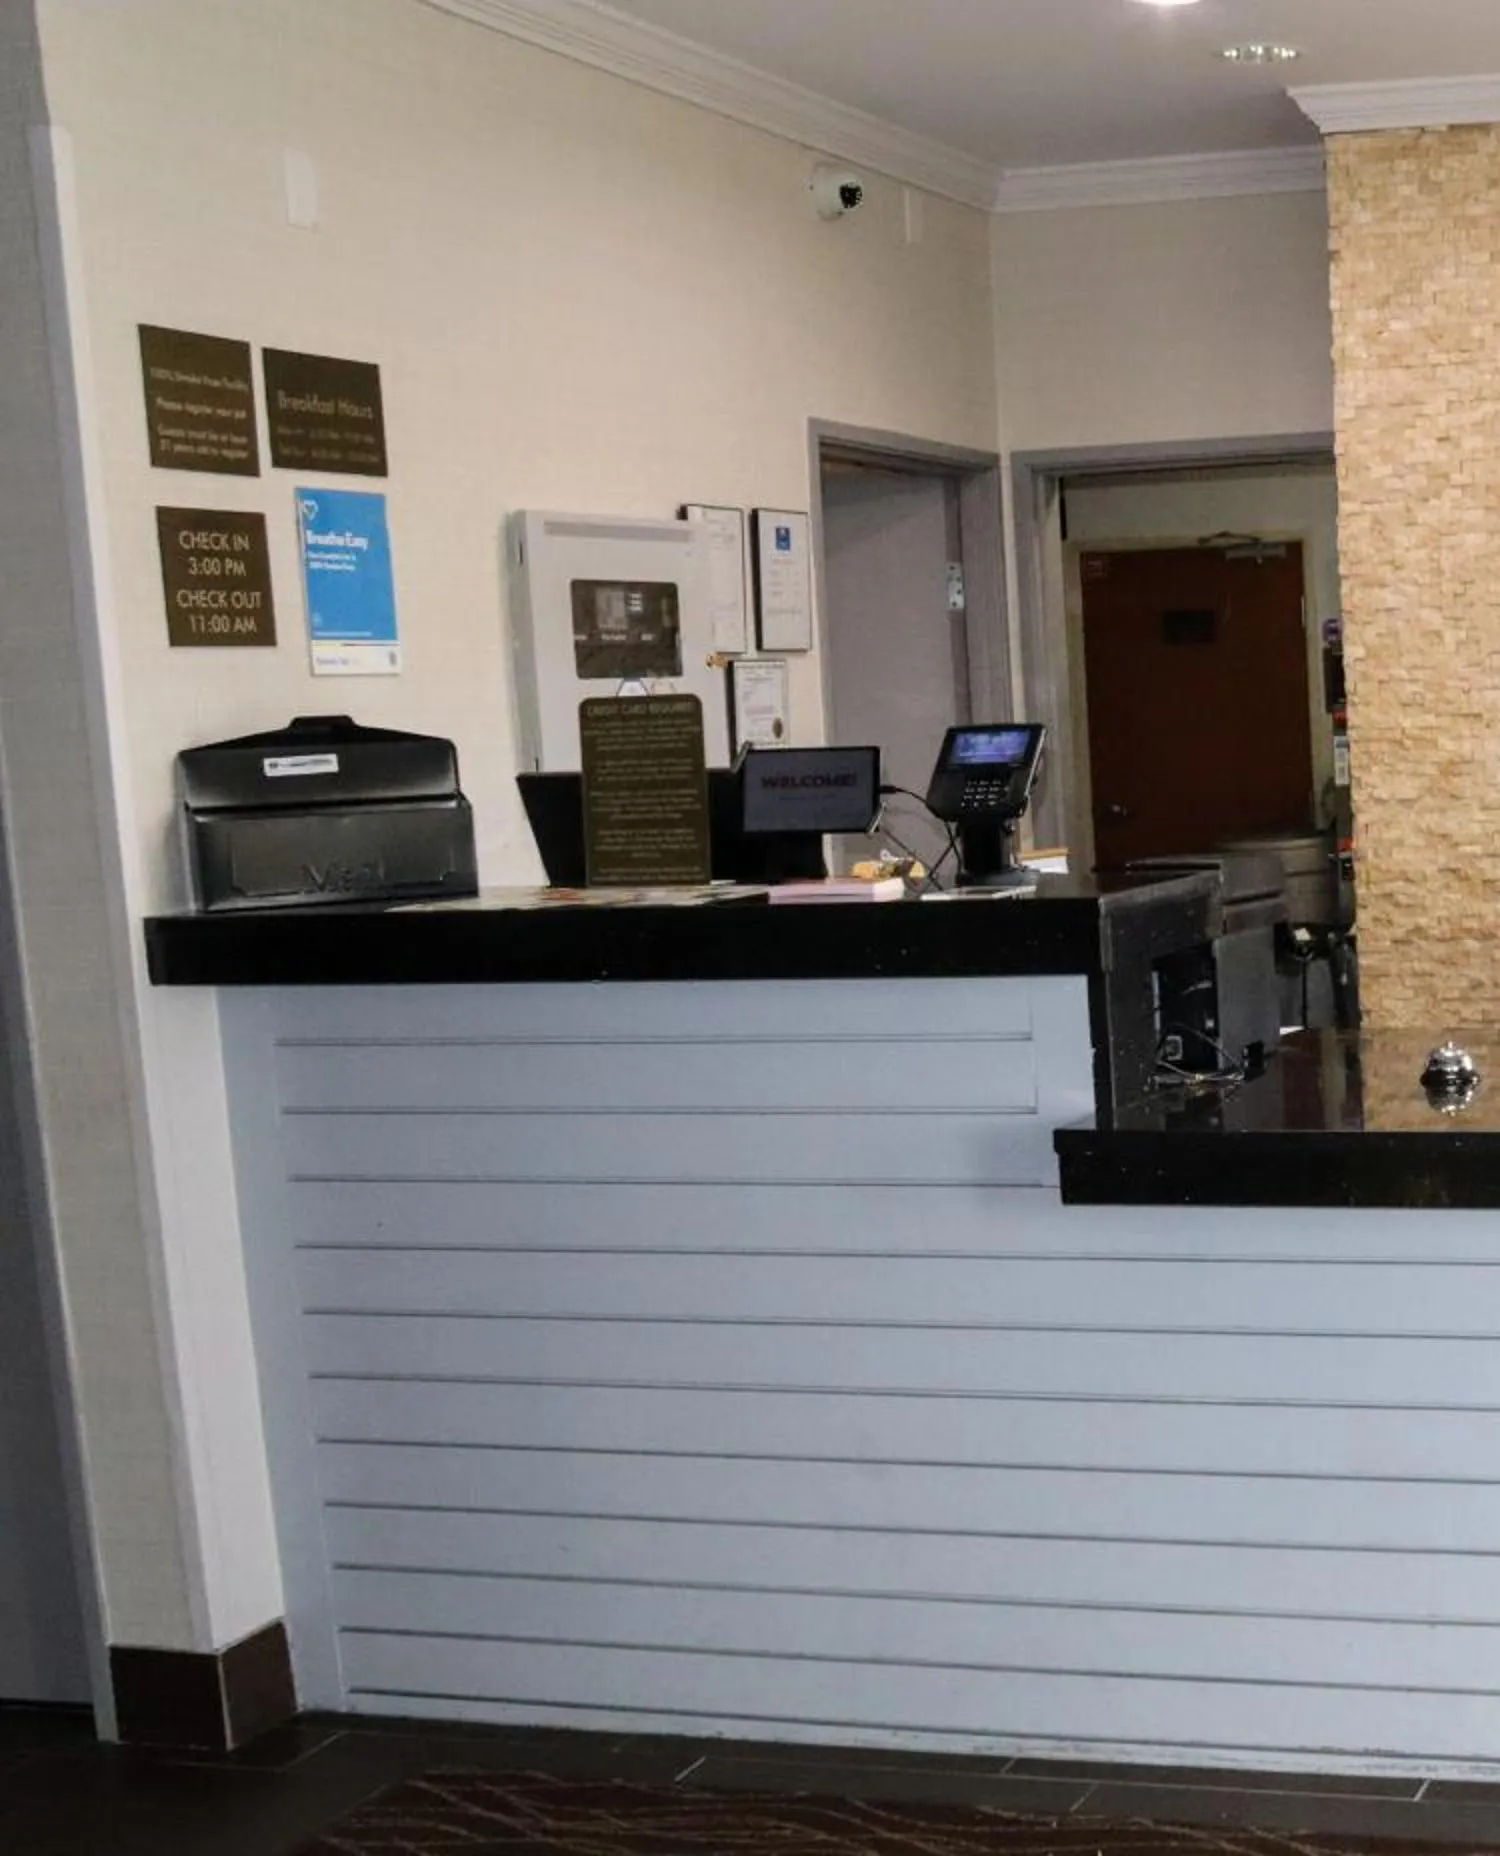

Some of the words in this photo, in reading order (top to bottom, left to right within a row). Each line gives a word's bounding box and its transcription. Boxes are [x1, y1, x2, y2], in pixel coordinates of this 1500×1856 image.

[277, 388, 336, 415] Breakfast
[337, 397, 374, 420] Hours
[178, 530, 231, 552] CHECK
[232, 533, 250, 552] IN
[187, 556, 221, 576] 3:00
[224, 557, 247, 577] PM
[175, 588, 230, 610] CHECK
[230, 590, 262, 610] OUT
[187, 612, 231, 634] 11:00
[232, 613, 258, 634] AM
[761, 772, 857, 790] WELCOME!
